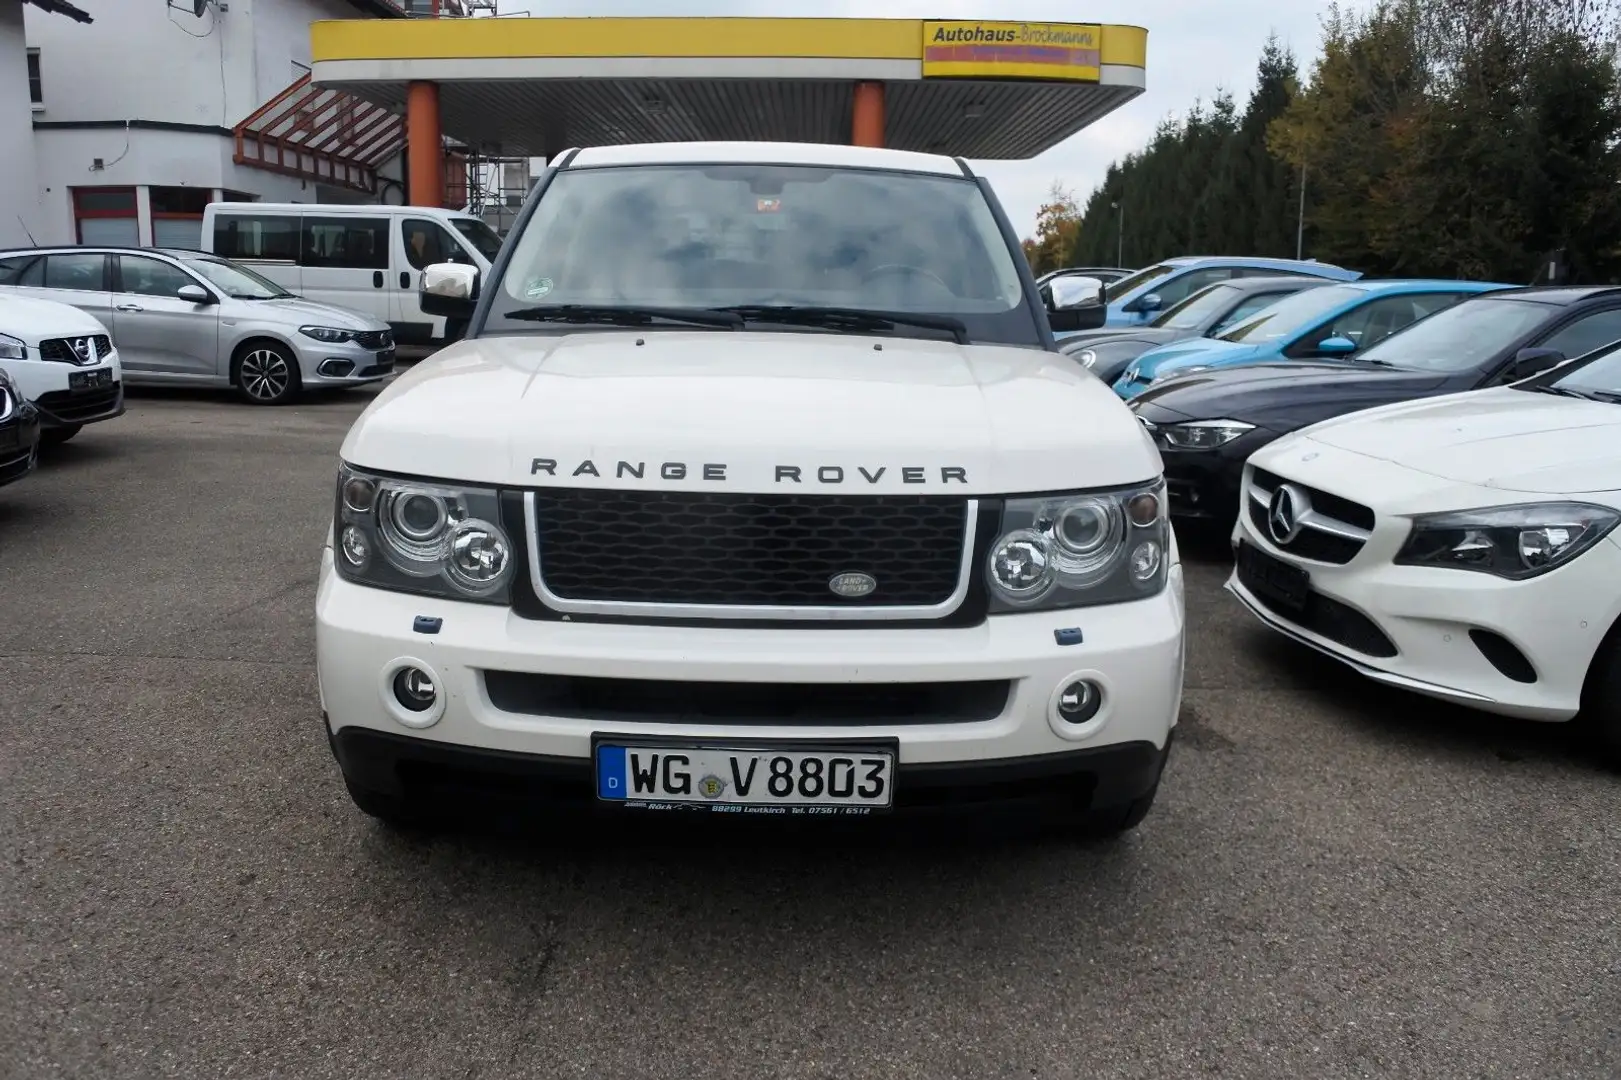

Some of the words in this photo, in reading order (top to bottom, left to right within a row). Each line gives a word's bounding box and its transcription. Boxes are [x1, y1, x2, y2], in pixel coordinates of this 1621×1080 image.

[531, 458, 727, 480] RANGE
[775, 465, 967, 483] ROVER
[608, 777, 618, 789] D
[630, 753, 691, 795] WG
[730, 756, 758, 796] V
[767, 757, 886, 799] 8803
